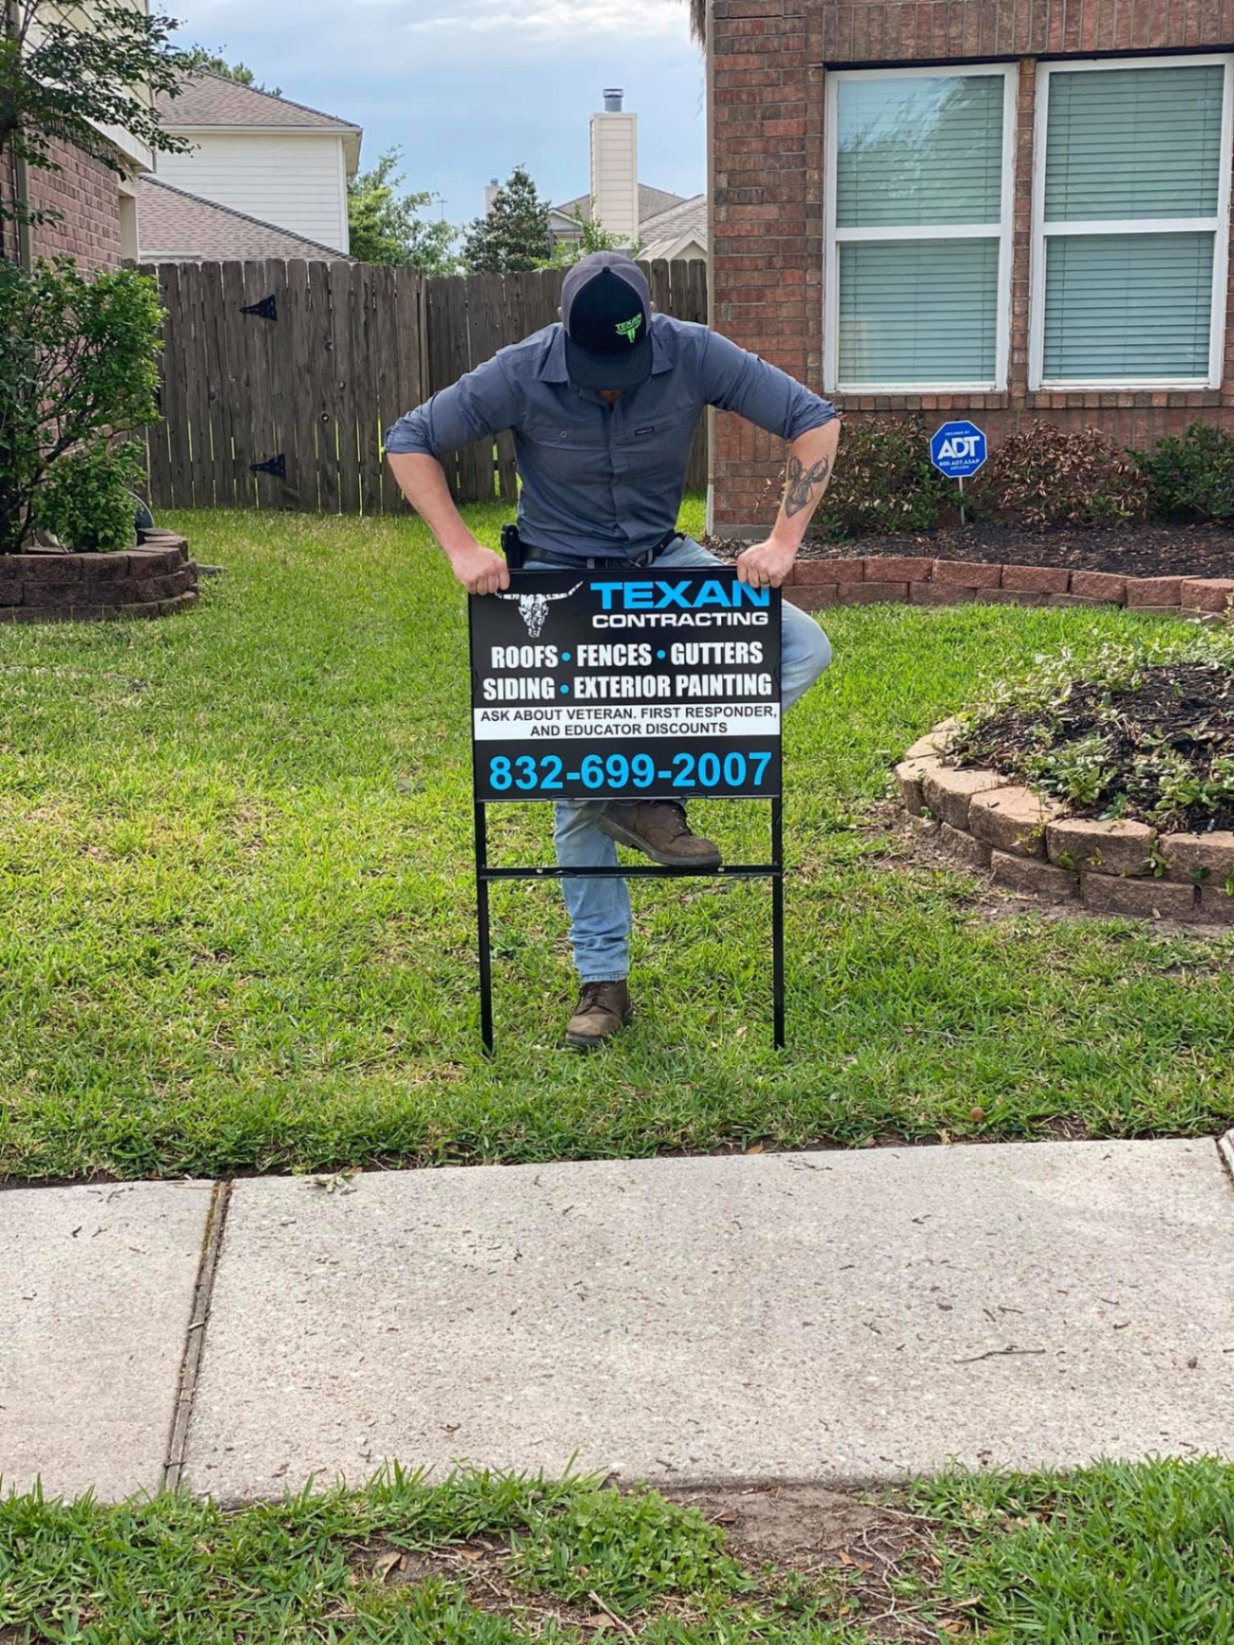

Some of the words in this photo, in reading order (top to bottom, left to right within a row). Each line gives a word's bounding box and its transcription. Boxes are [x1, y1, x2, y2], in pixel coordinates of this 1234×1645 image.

[937, 435, 980, 460] ADT
[590, 580, 770, 609] TEXAN
[592, 612, 769, 628] CONTRACTING
[491, 645, 558, 668] ROOFS
[577, 644, 652, 667] FENCES
[670, 641, 763, 665] GUTTERS
[483, 677, 555, 700] SIDING
[574, 675, 671, 699] EXTERIOR
[676, 673, 772, 697] PAINTING
[480, 710, 512, 721] ASK
[514, 709, 561, 720] ABOUT
[641, 707, 681, 718] FIRST
[685, 706, 777, 718] RESPONDER,
[531, 725, 560, 736] AND
[565, 724, 641, 735] EDUCATOR
[646, 722, 728, 734] DISCOUNTS
[489, 752, 772, 790] 832-699-2007
